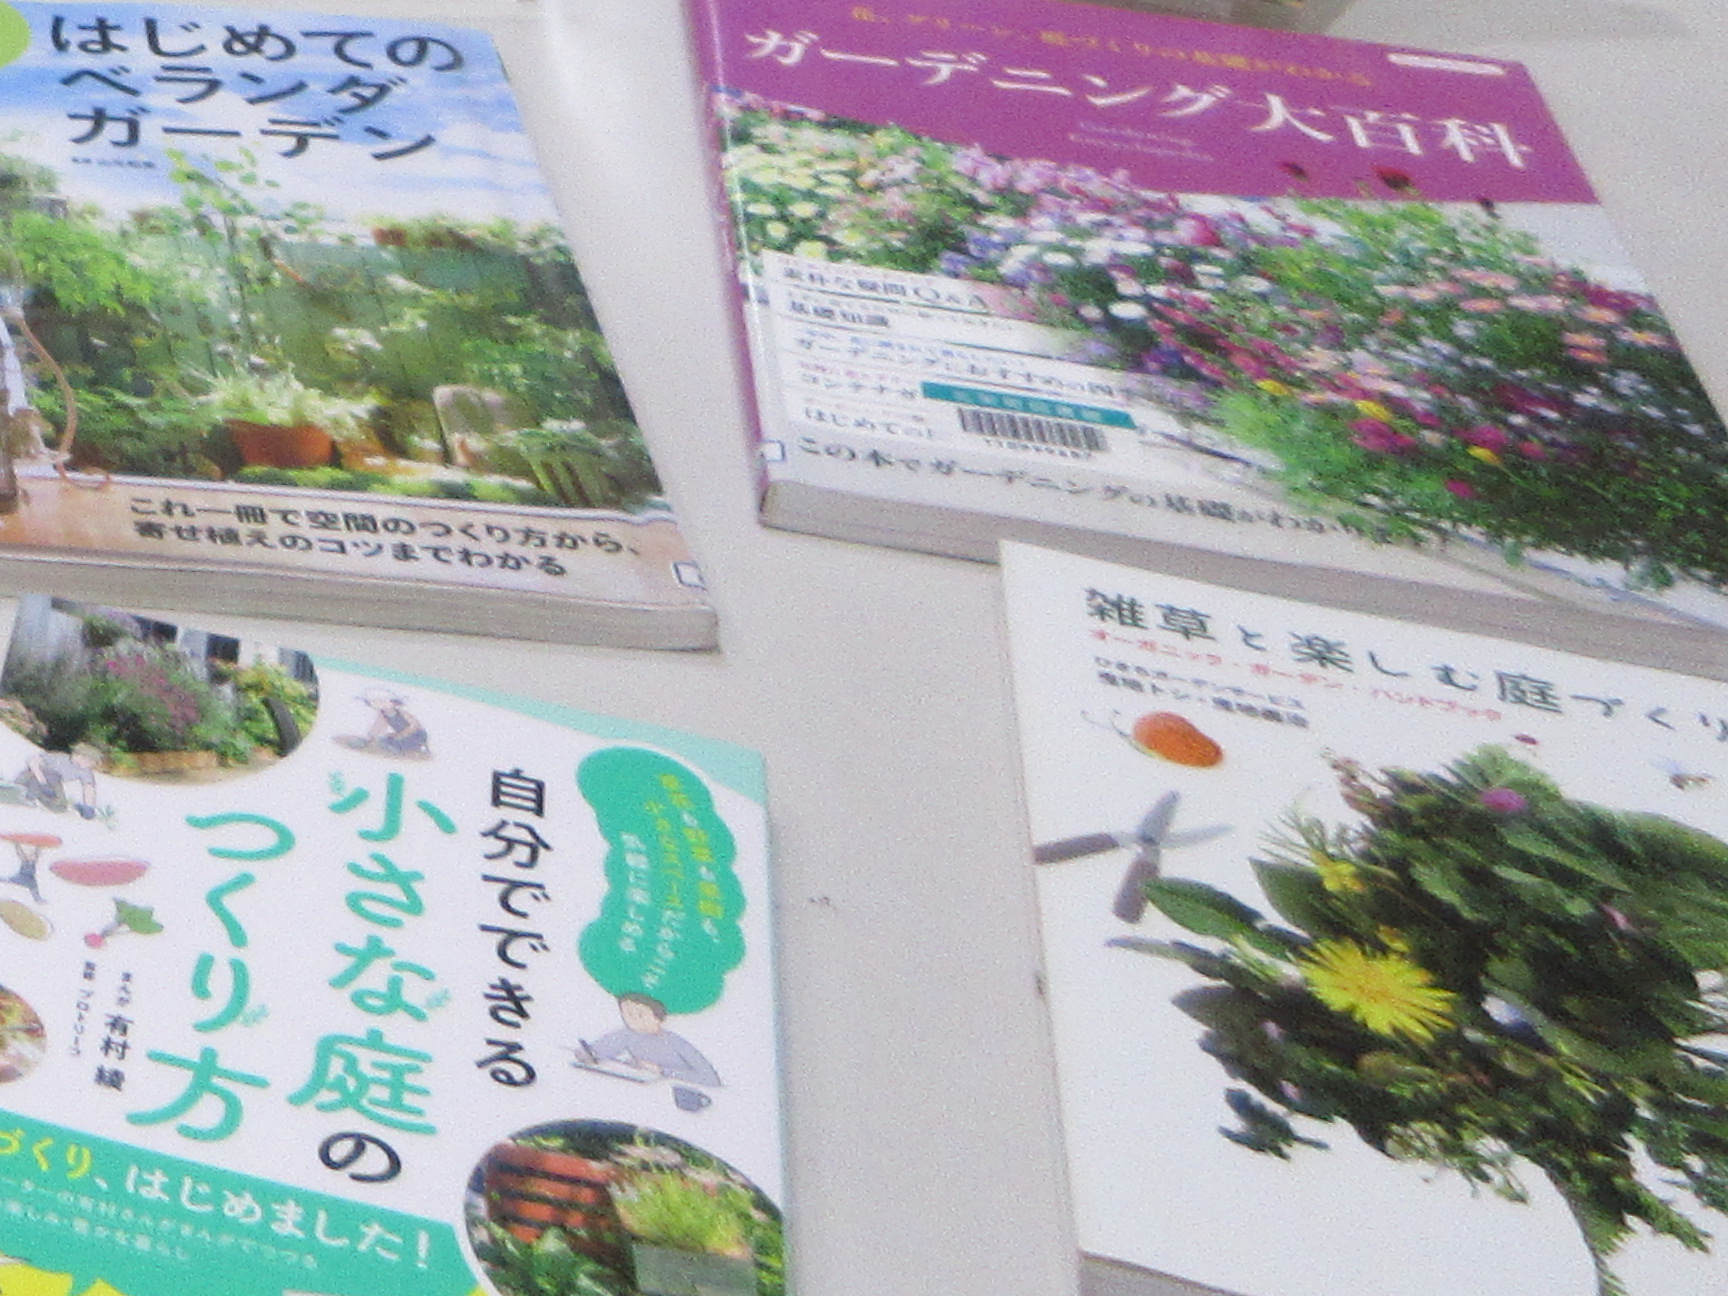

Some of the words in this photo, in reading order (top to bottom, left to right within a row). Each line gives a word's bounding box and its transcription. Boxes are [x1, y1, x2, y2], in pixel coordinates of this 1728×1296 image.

[49, 12, 464, 75] はじめての
[60, 64, 411, 114] ベランダ
[66, 106, 439, 163] ガーデン
[745, 26, 1534, 170] ガーデニング大百科
[132, 520, 568, 579] 寄せ植えのコツまでわかる
[125, 809, 297, 1144] つくり方
[286, 771, 458, 1185] 小さな庭の
[476, 767, 548, 1091] 自分でできる
